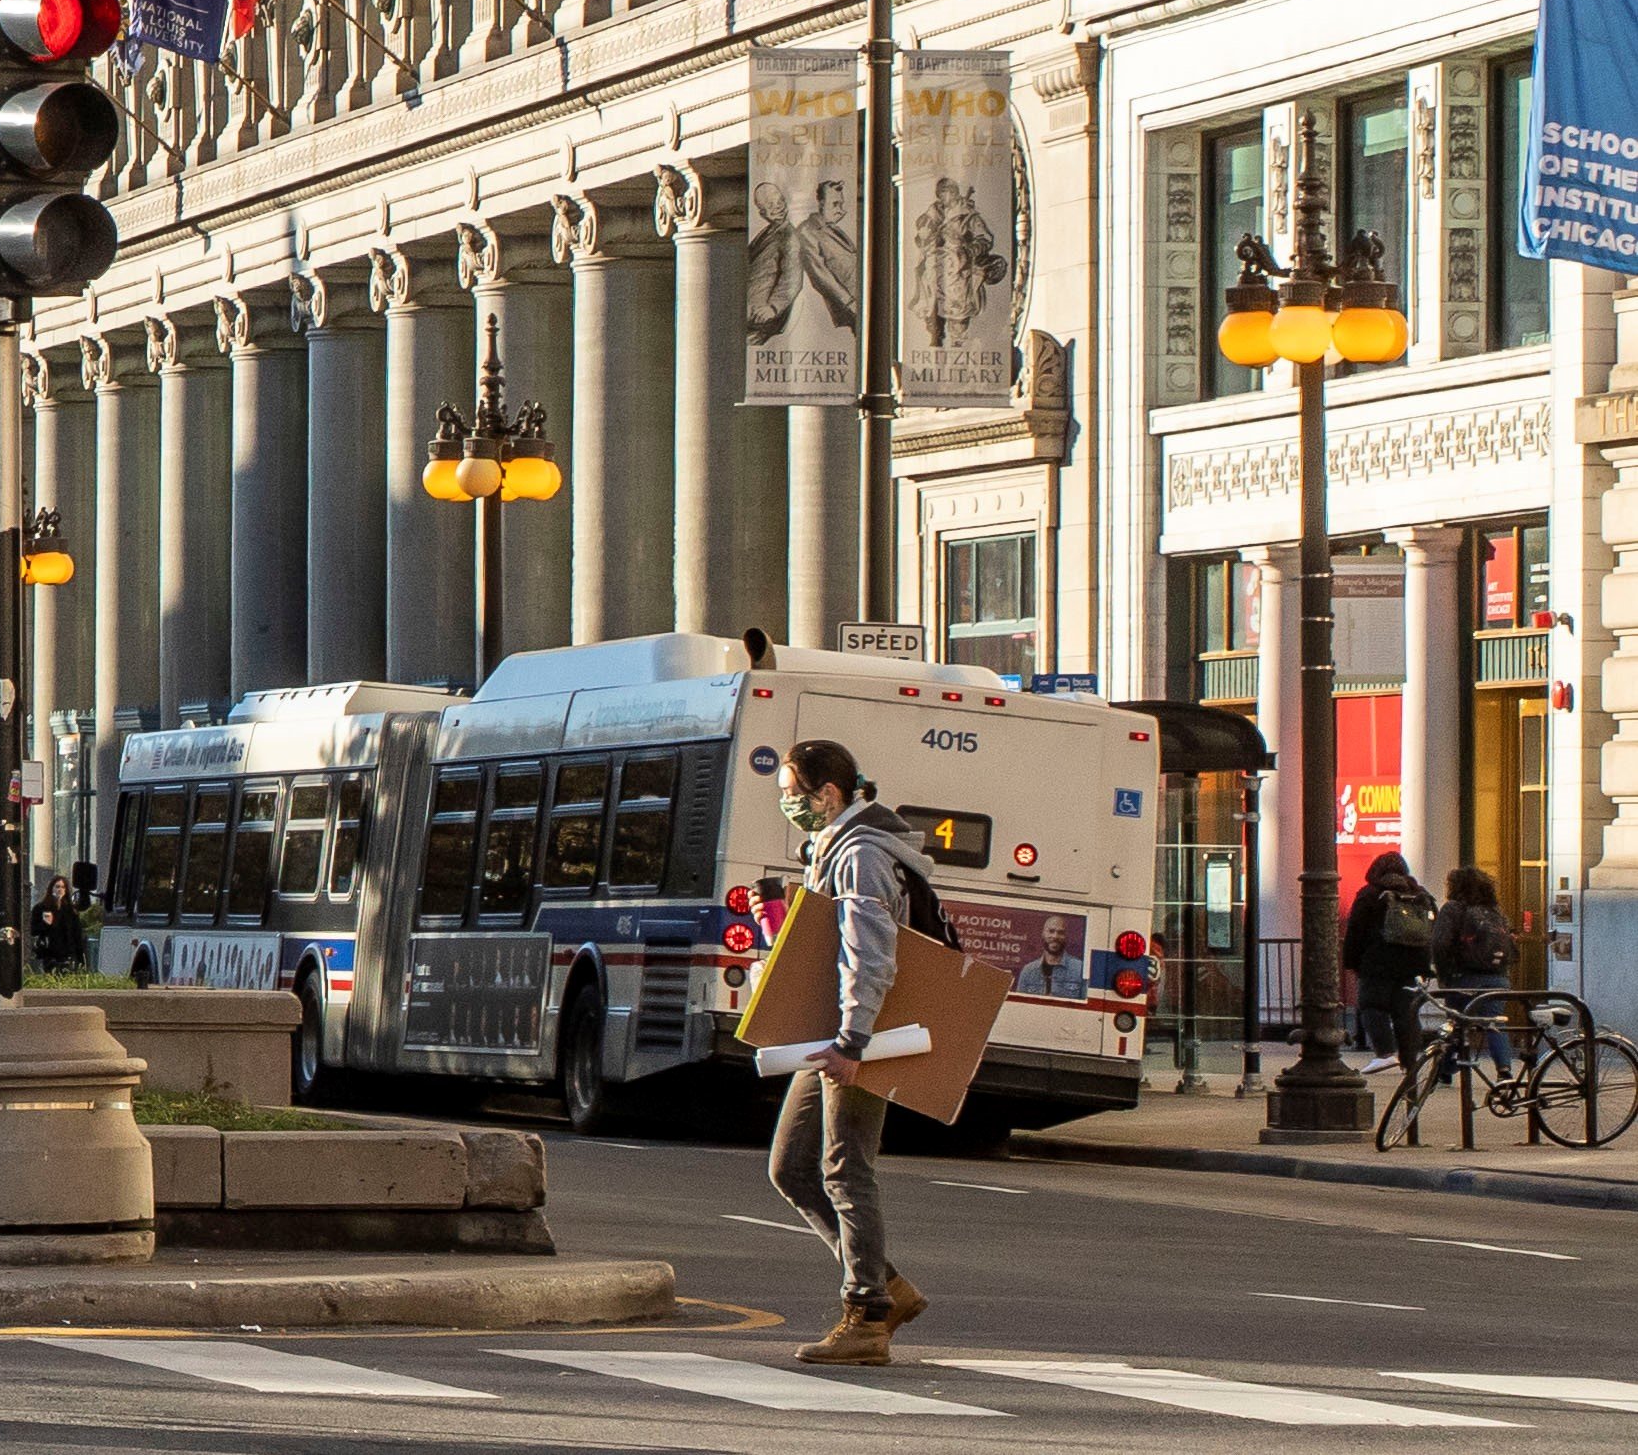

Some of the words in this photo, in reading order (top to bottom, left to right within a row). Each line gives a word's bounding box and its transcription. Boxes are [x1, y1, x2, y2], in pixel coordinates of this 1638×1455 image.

[141, 0, 203, 31] NATIONAL
[149, 14, 186, 38] LOUIS
[141, 21, 204, 54] NIVERSITY
[753, 90, 856, 117] WHO
[905, 90, 1007, 117] WHO
[757, 124, 780, 146] IS
[792, 124, 853, 146] BILL
[908, 124, 932, 145] IS
[943, 124, 1007, 146] BILL
[1538, 154, 1579, 179] OF
[1584, 161, 1638, 193] THE
[1530, 217, 1638, 257] CHICAG
[755, 350, 849, 366] PRITZKER
[910, 350, 1004, 366] PRITZKER
[755, 368, 849, 384] MILITARY
[909, 368, 1004, 384] MILITARY
[847, 633, 919, 651] SPEED
[1072, 677, 1091, 687] bus
[920, 728, 978, 753] 4015
[754, 756, 774, 766] cta
[935, 818, 954, 849] 4
[959, 914, 1012, 929] MOTION
